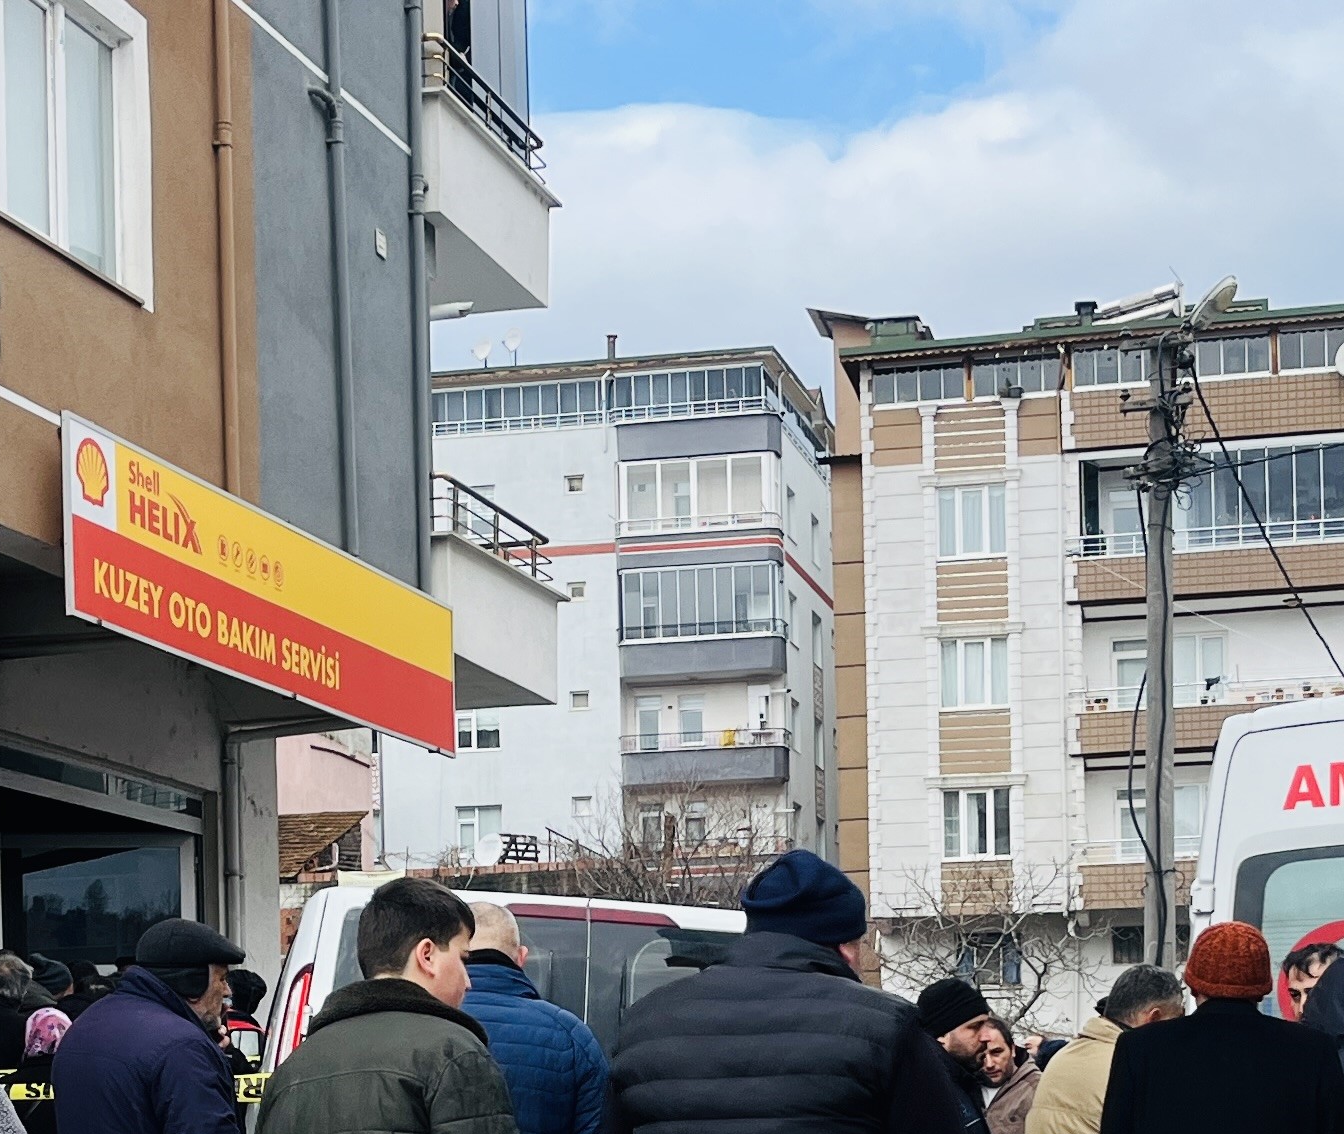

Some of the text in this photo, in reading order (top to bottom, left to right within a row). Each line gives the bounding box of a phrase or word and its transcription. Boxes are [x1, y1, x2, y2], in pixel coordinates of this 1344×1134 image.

[128, 460, 160, 496] Shell
[128, 489, 203, 556] HELIX
[93, 557, 163, 619] KUZEY
[168, 591, 212, 639] OTO
[217, 610, 277, 666] BAKIM
[281, 637, 340, 690] SERVİSİ
